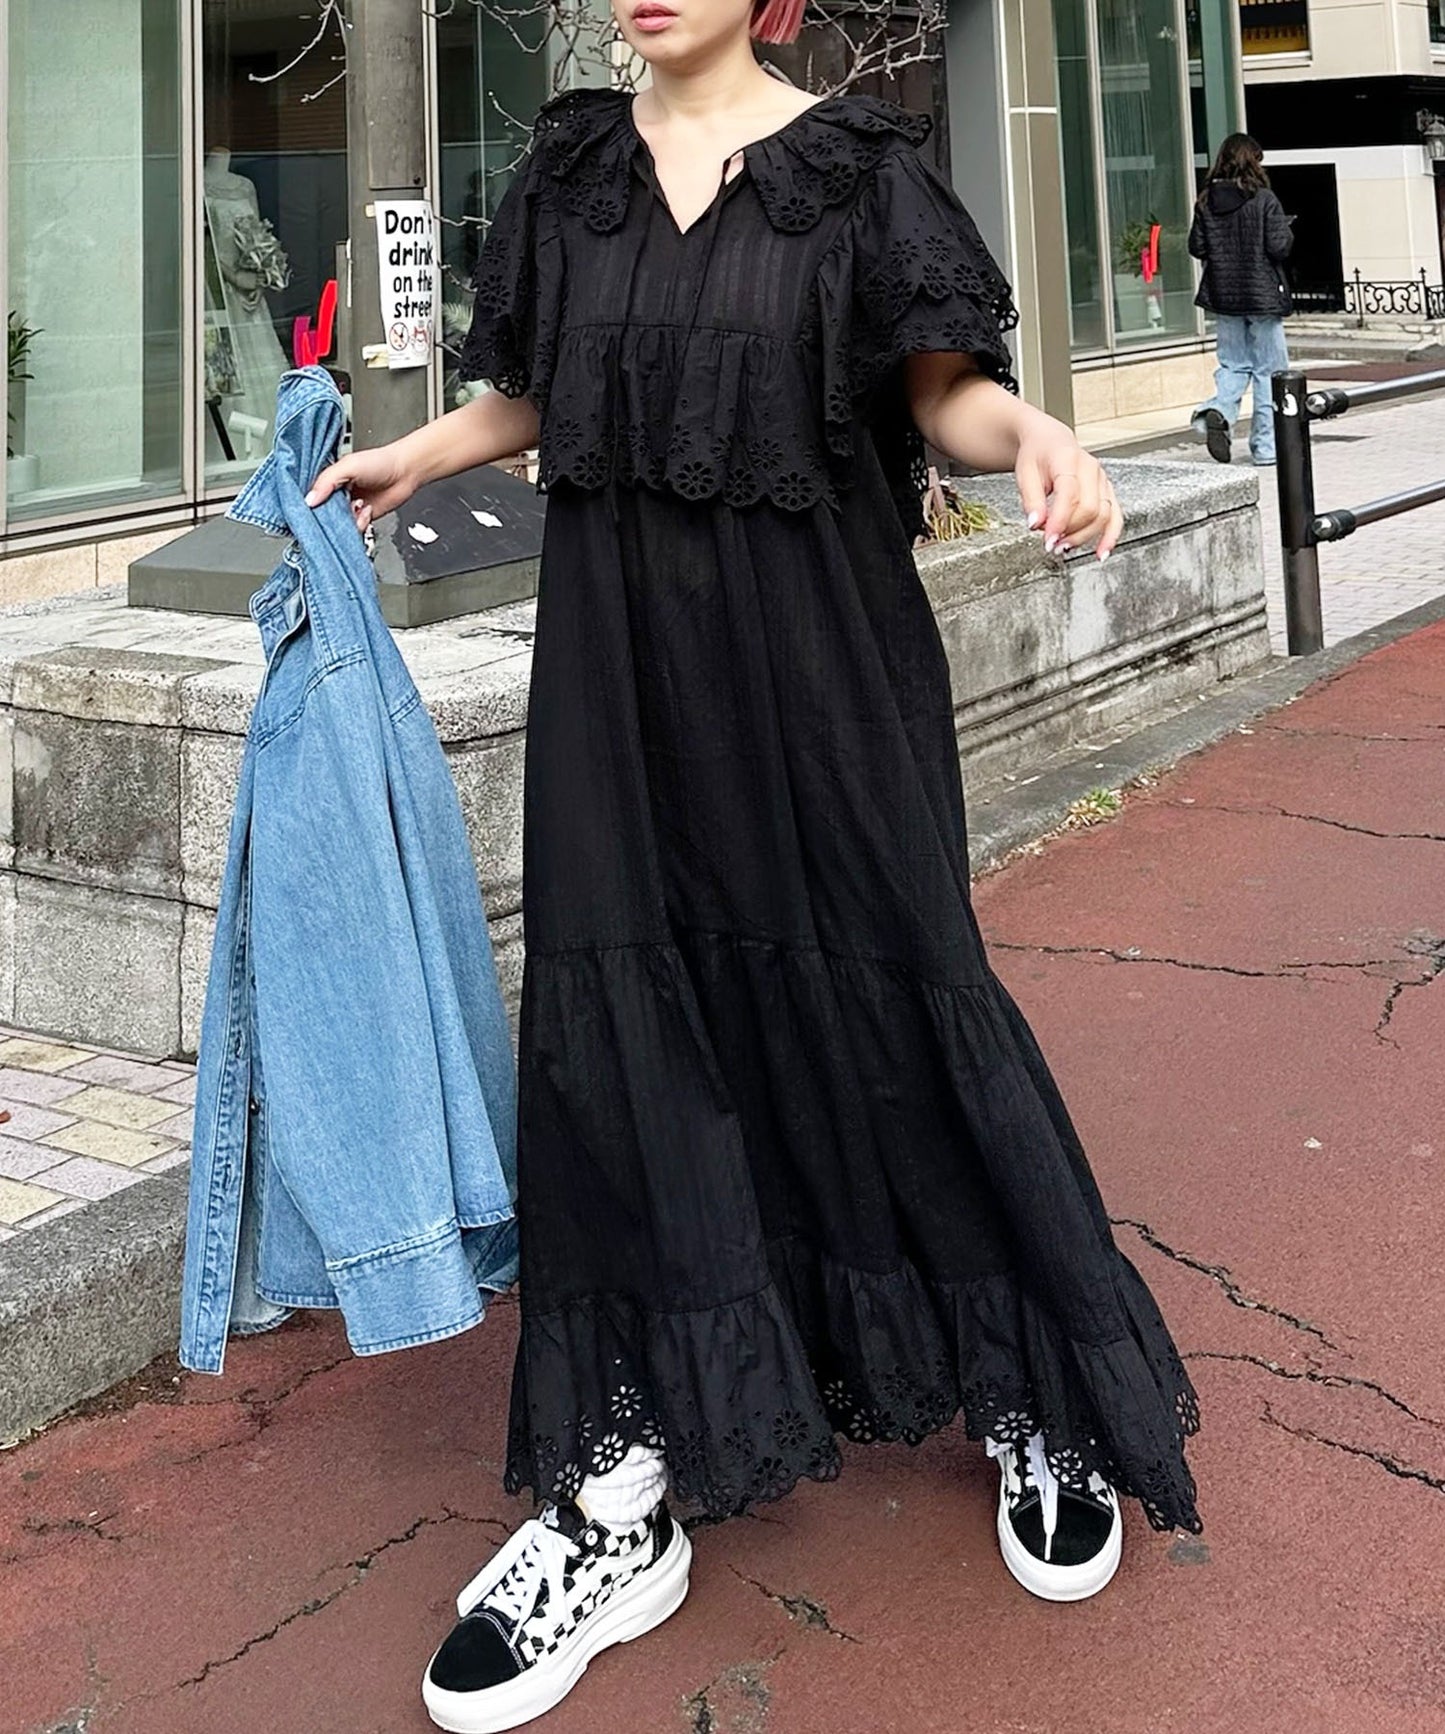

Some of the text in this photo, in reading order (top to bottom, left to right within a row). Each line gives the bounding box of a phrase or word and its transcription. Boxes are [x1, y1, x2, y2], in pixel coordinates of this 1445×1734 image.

[385, 209, 432, 234] Don't
[389, 241, 433, 266] drink
[393, 270, 432, 292] on the
[394, 295, 432, 318] street
